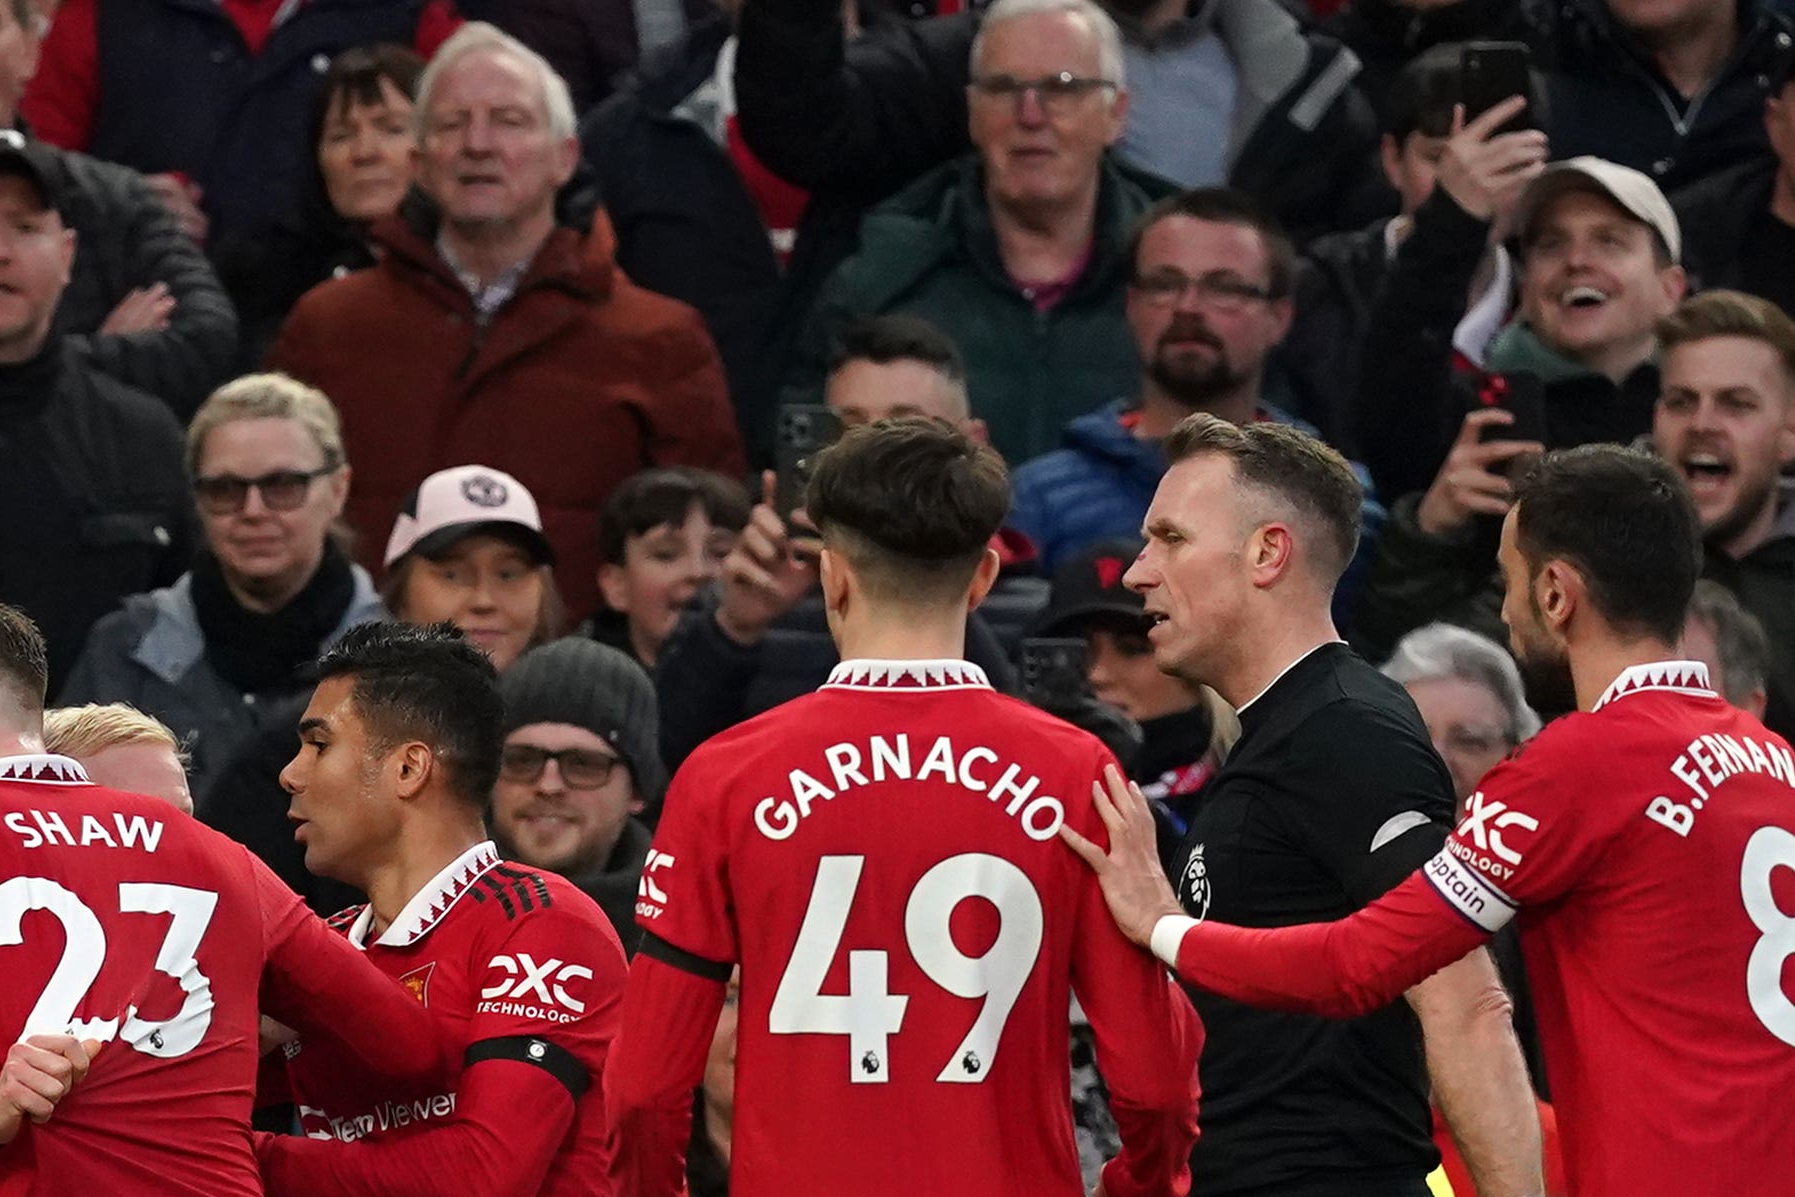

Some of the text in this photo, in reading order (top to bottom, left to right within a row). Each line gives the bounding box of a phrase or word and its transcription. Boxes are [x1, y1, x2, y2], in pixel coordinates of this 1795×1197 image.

[754, 733, 1065, 841] GARNACHO
[4, 809, 164, 853] SHAW
[1431, 855, 1485, 914] aptain
[481, 953, 593, 1013] DXC
[769, 853, 1044, 1084] 49
